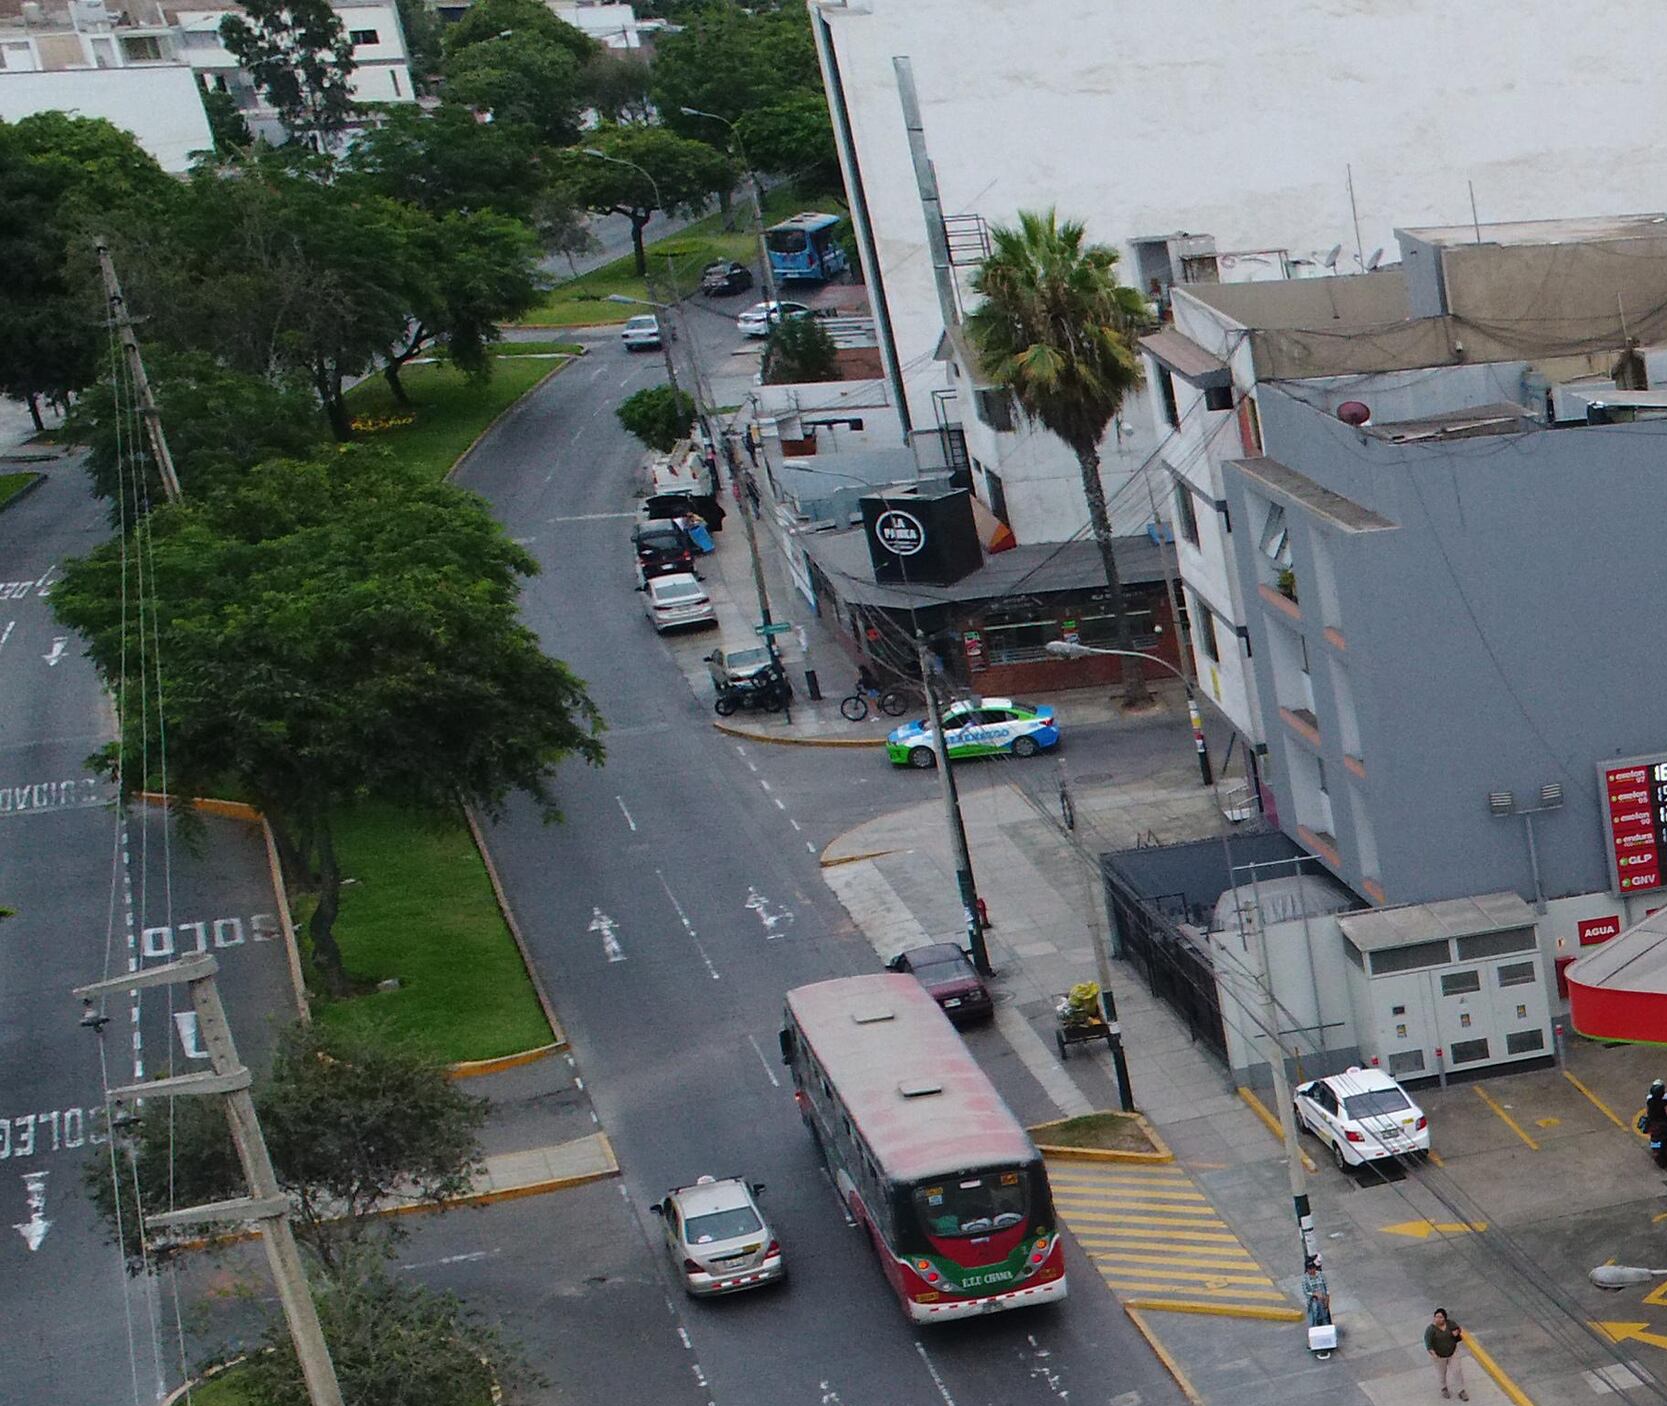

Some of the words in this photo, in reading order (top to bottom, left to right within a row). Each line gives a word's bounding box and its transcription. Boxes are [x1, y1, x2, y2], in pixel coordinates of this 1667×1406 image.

[1628, 854, 1652, 865] GLP
[1631, 874, 1656, 885] GNV
[143, 913, 281, 957] SOLO
[1584, 925, 1615, 938] AGUA
